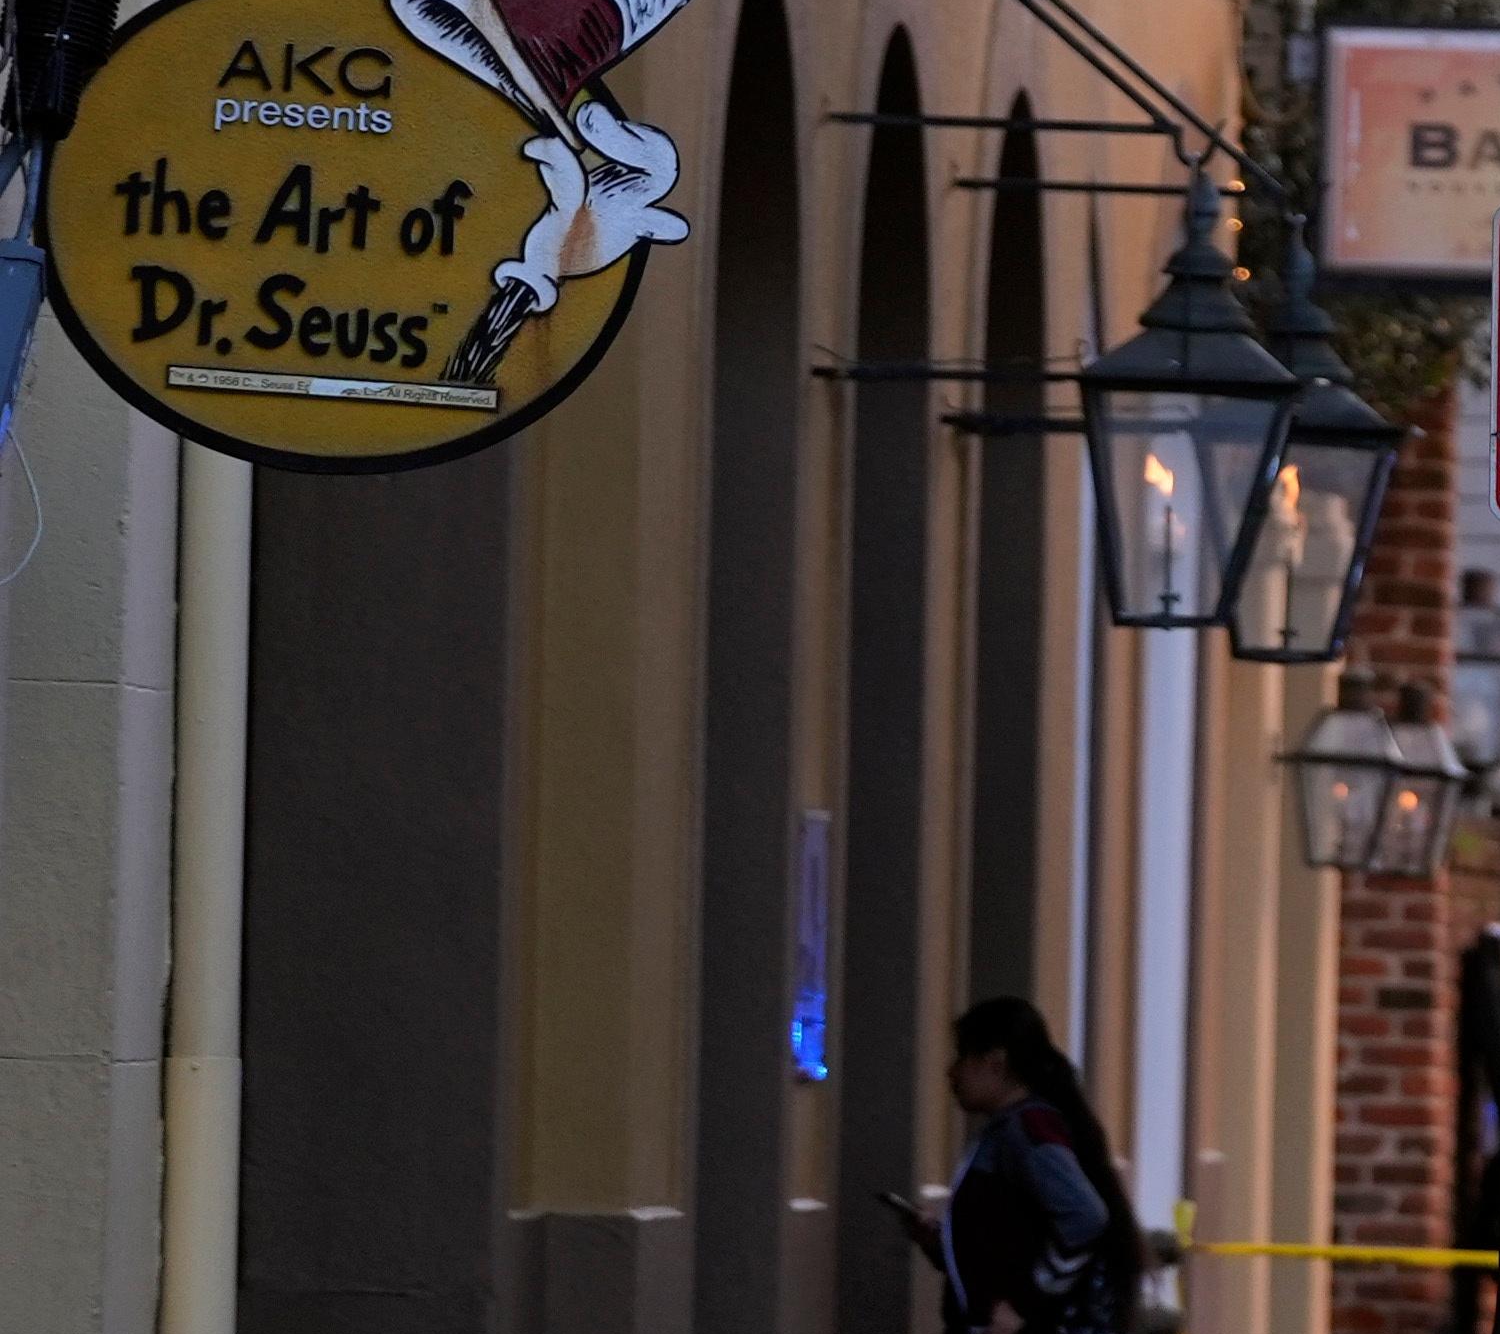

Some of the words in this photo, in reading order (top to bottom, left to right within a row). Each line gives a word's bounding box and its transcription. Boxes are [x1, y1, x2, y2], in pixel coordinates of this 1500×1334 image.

[213, 97, 392, 134] presents
[115, 157, 231, 241] the
[254, 164, 381, 253] Art
[401, 178, 474, 256] of
[131, 264, 233, 356] Dr.
